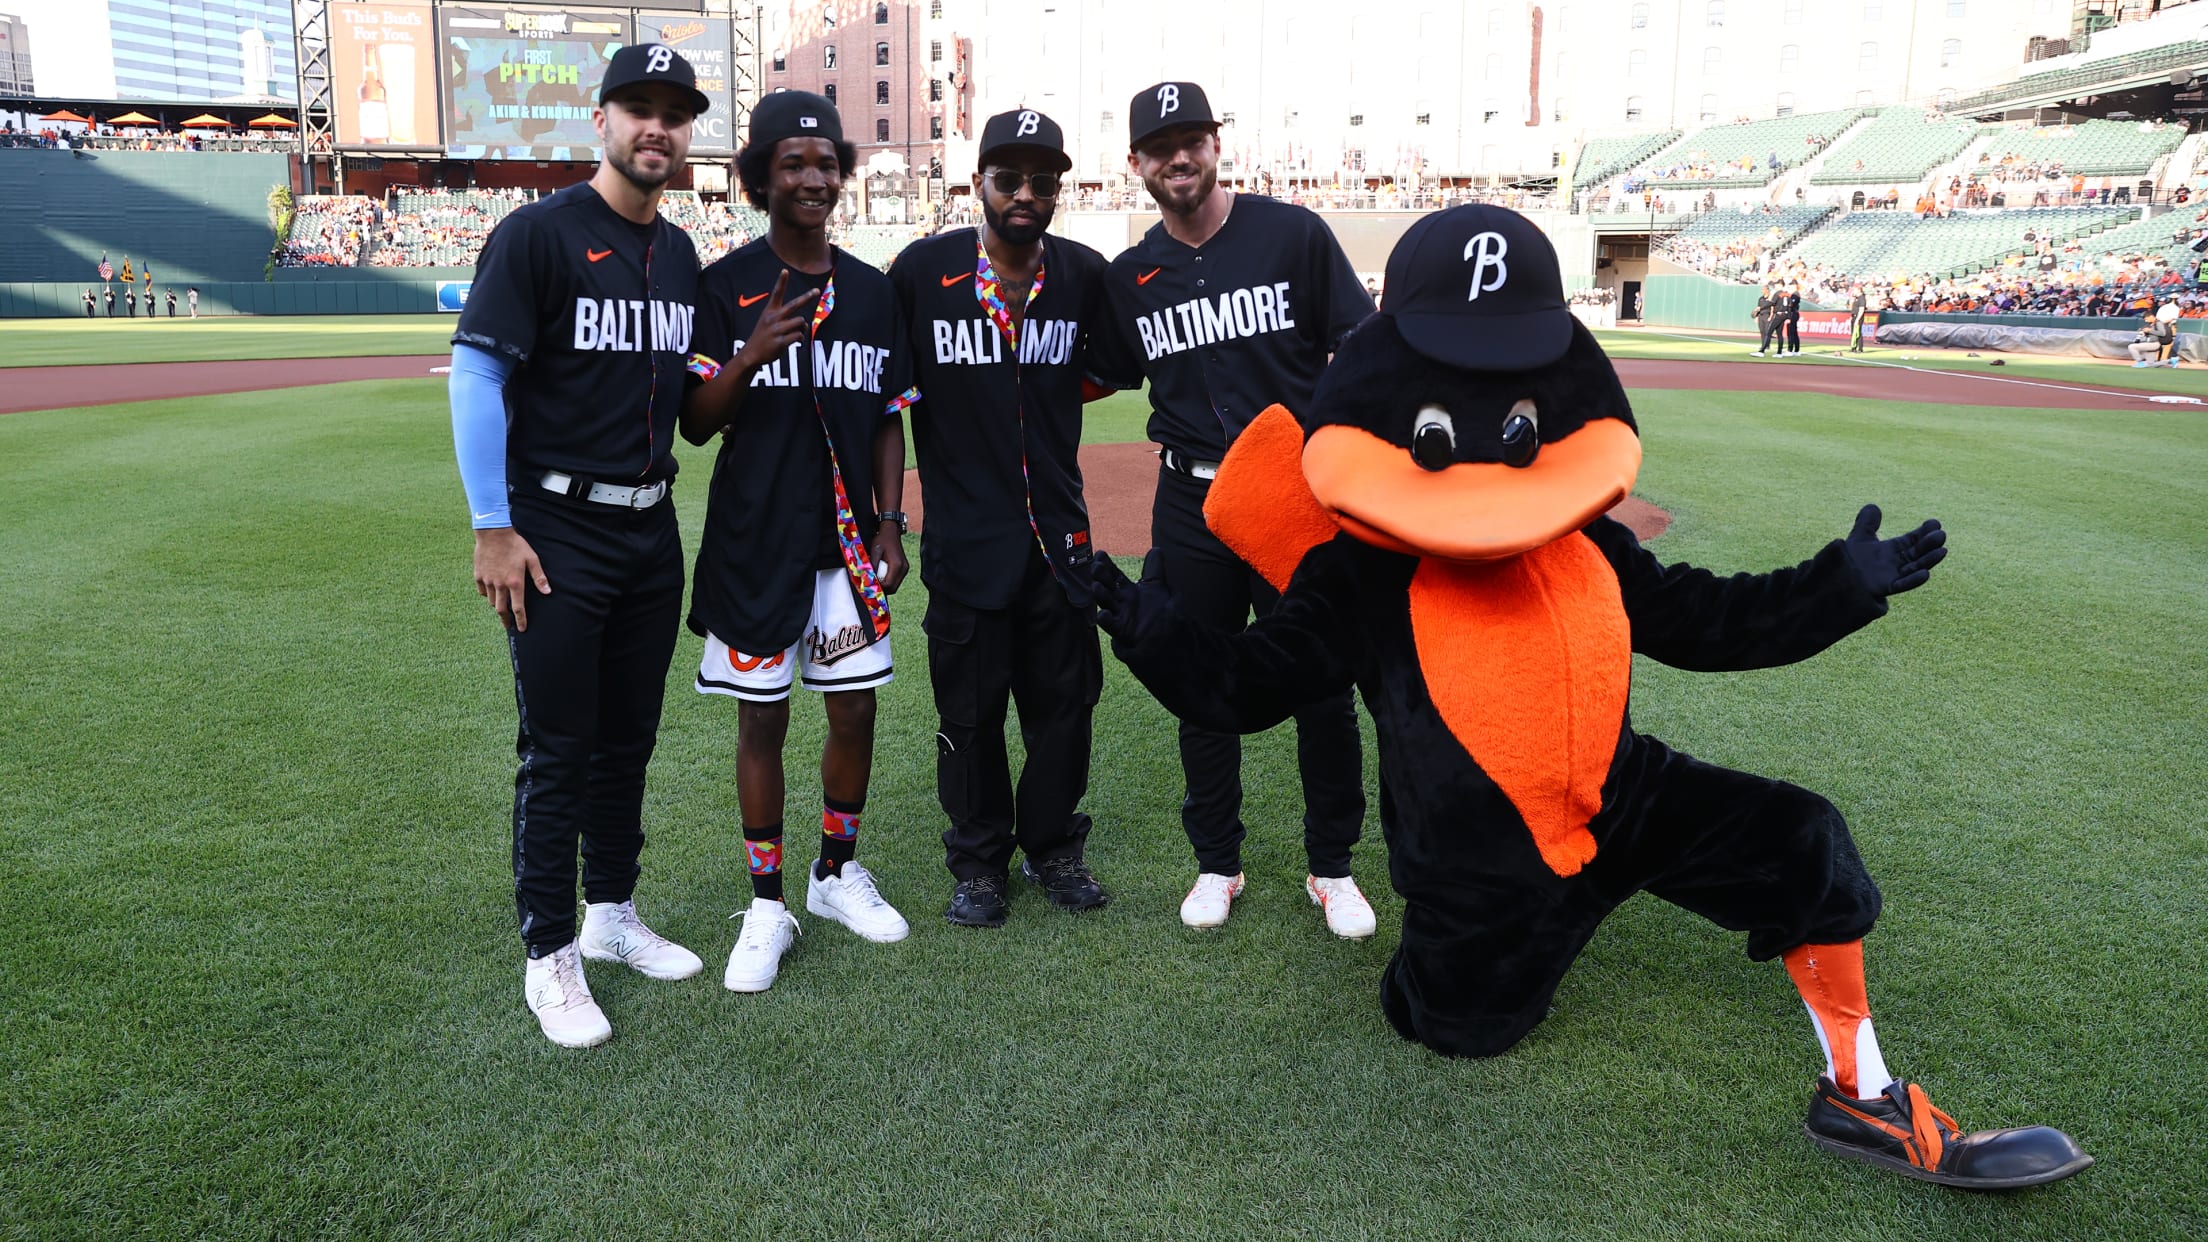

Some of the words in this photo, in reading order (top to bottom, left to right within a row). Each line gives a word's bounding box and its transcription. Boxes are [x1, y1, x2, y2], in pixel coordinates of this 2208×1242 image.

[341, 9, 378, 24] This
[383, 11, 422, 25] Bud's
[353, 26, 379, 41] For
[381, 27, 414, 42] You.
[518, 30, 554, 39] SPORTS
[524, 49, 552, 65] FIRST
[645, 45, 673, 74] B
[703, 50, 724, 63] WE
[499, 62, 578, 85] PITCH
[712, 65, 723, 77] A
[1157, 83, 1180, 119] B
[488, 104, 520, 119] AKIM
[1016, 110, 1041, 138] B
[1463, 231, 1508, 302] B
[1135, 281, 1295, 361] BALTIMORE
